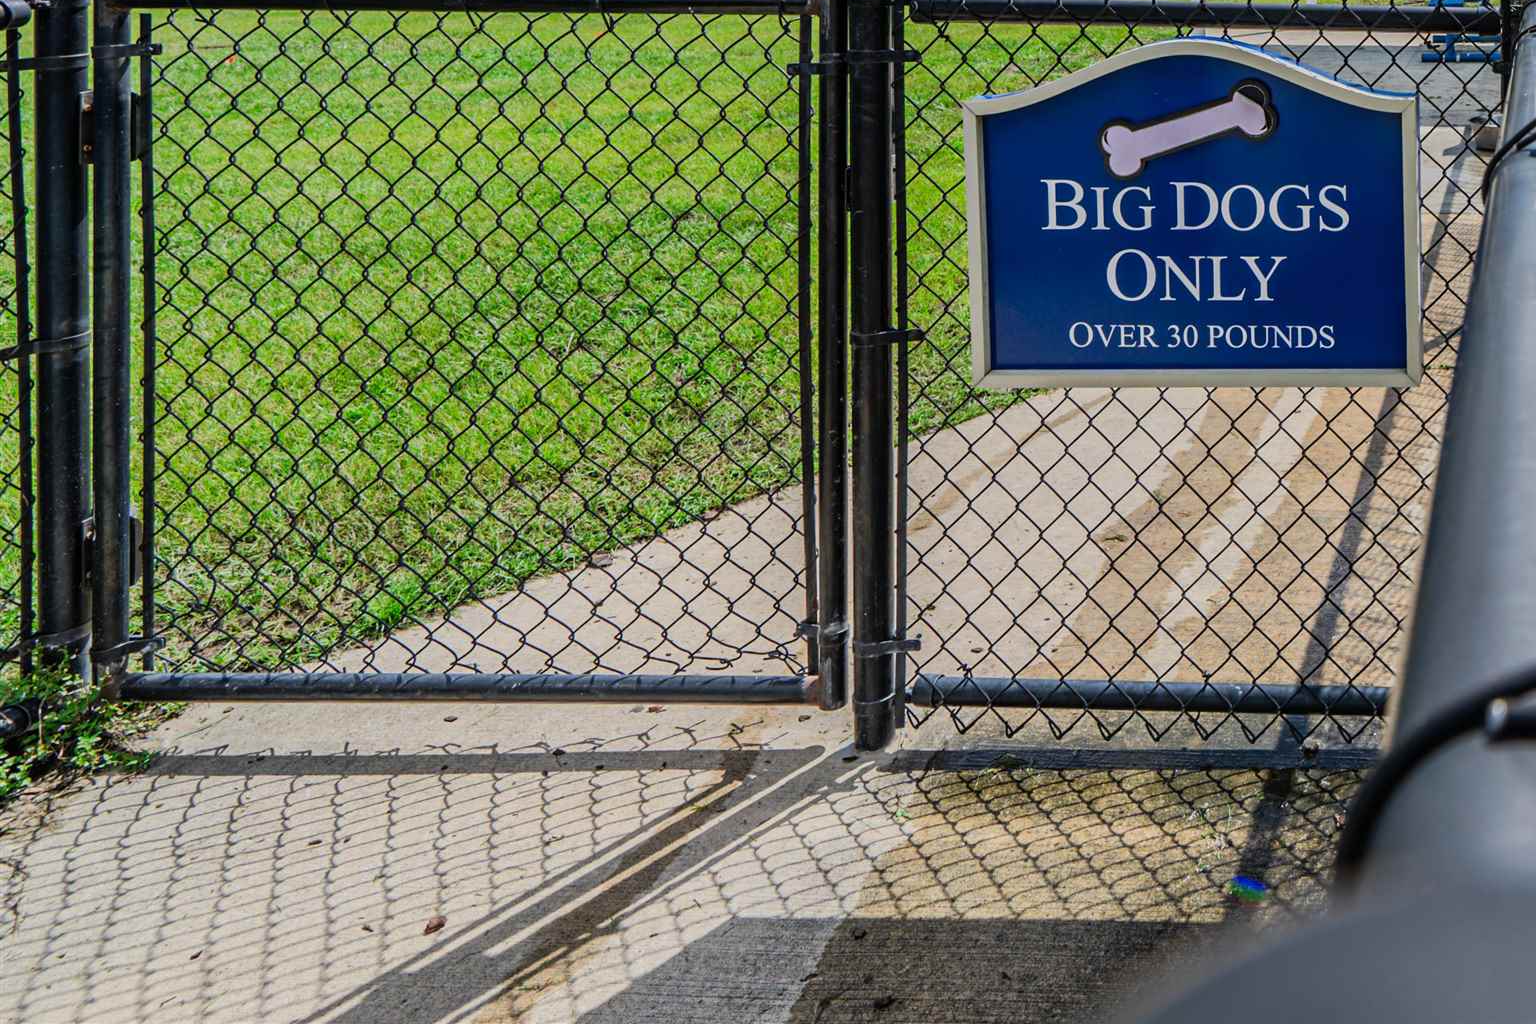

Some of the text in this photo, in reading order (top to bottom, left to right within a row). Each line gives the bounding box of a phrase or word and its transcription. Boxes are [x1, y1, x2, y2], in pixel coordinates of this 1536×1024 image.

[1040, 179, 1350, 232] BIG DOGS
[1106, 248, 1288, 302] ONLY
[1069, 321, 1335, 349] OVER 30 POUNDS
